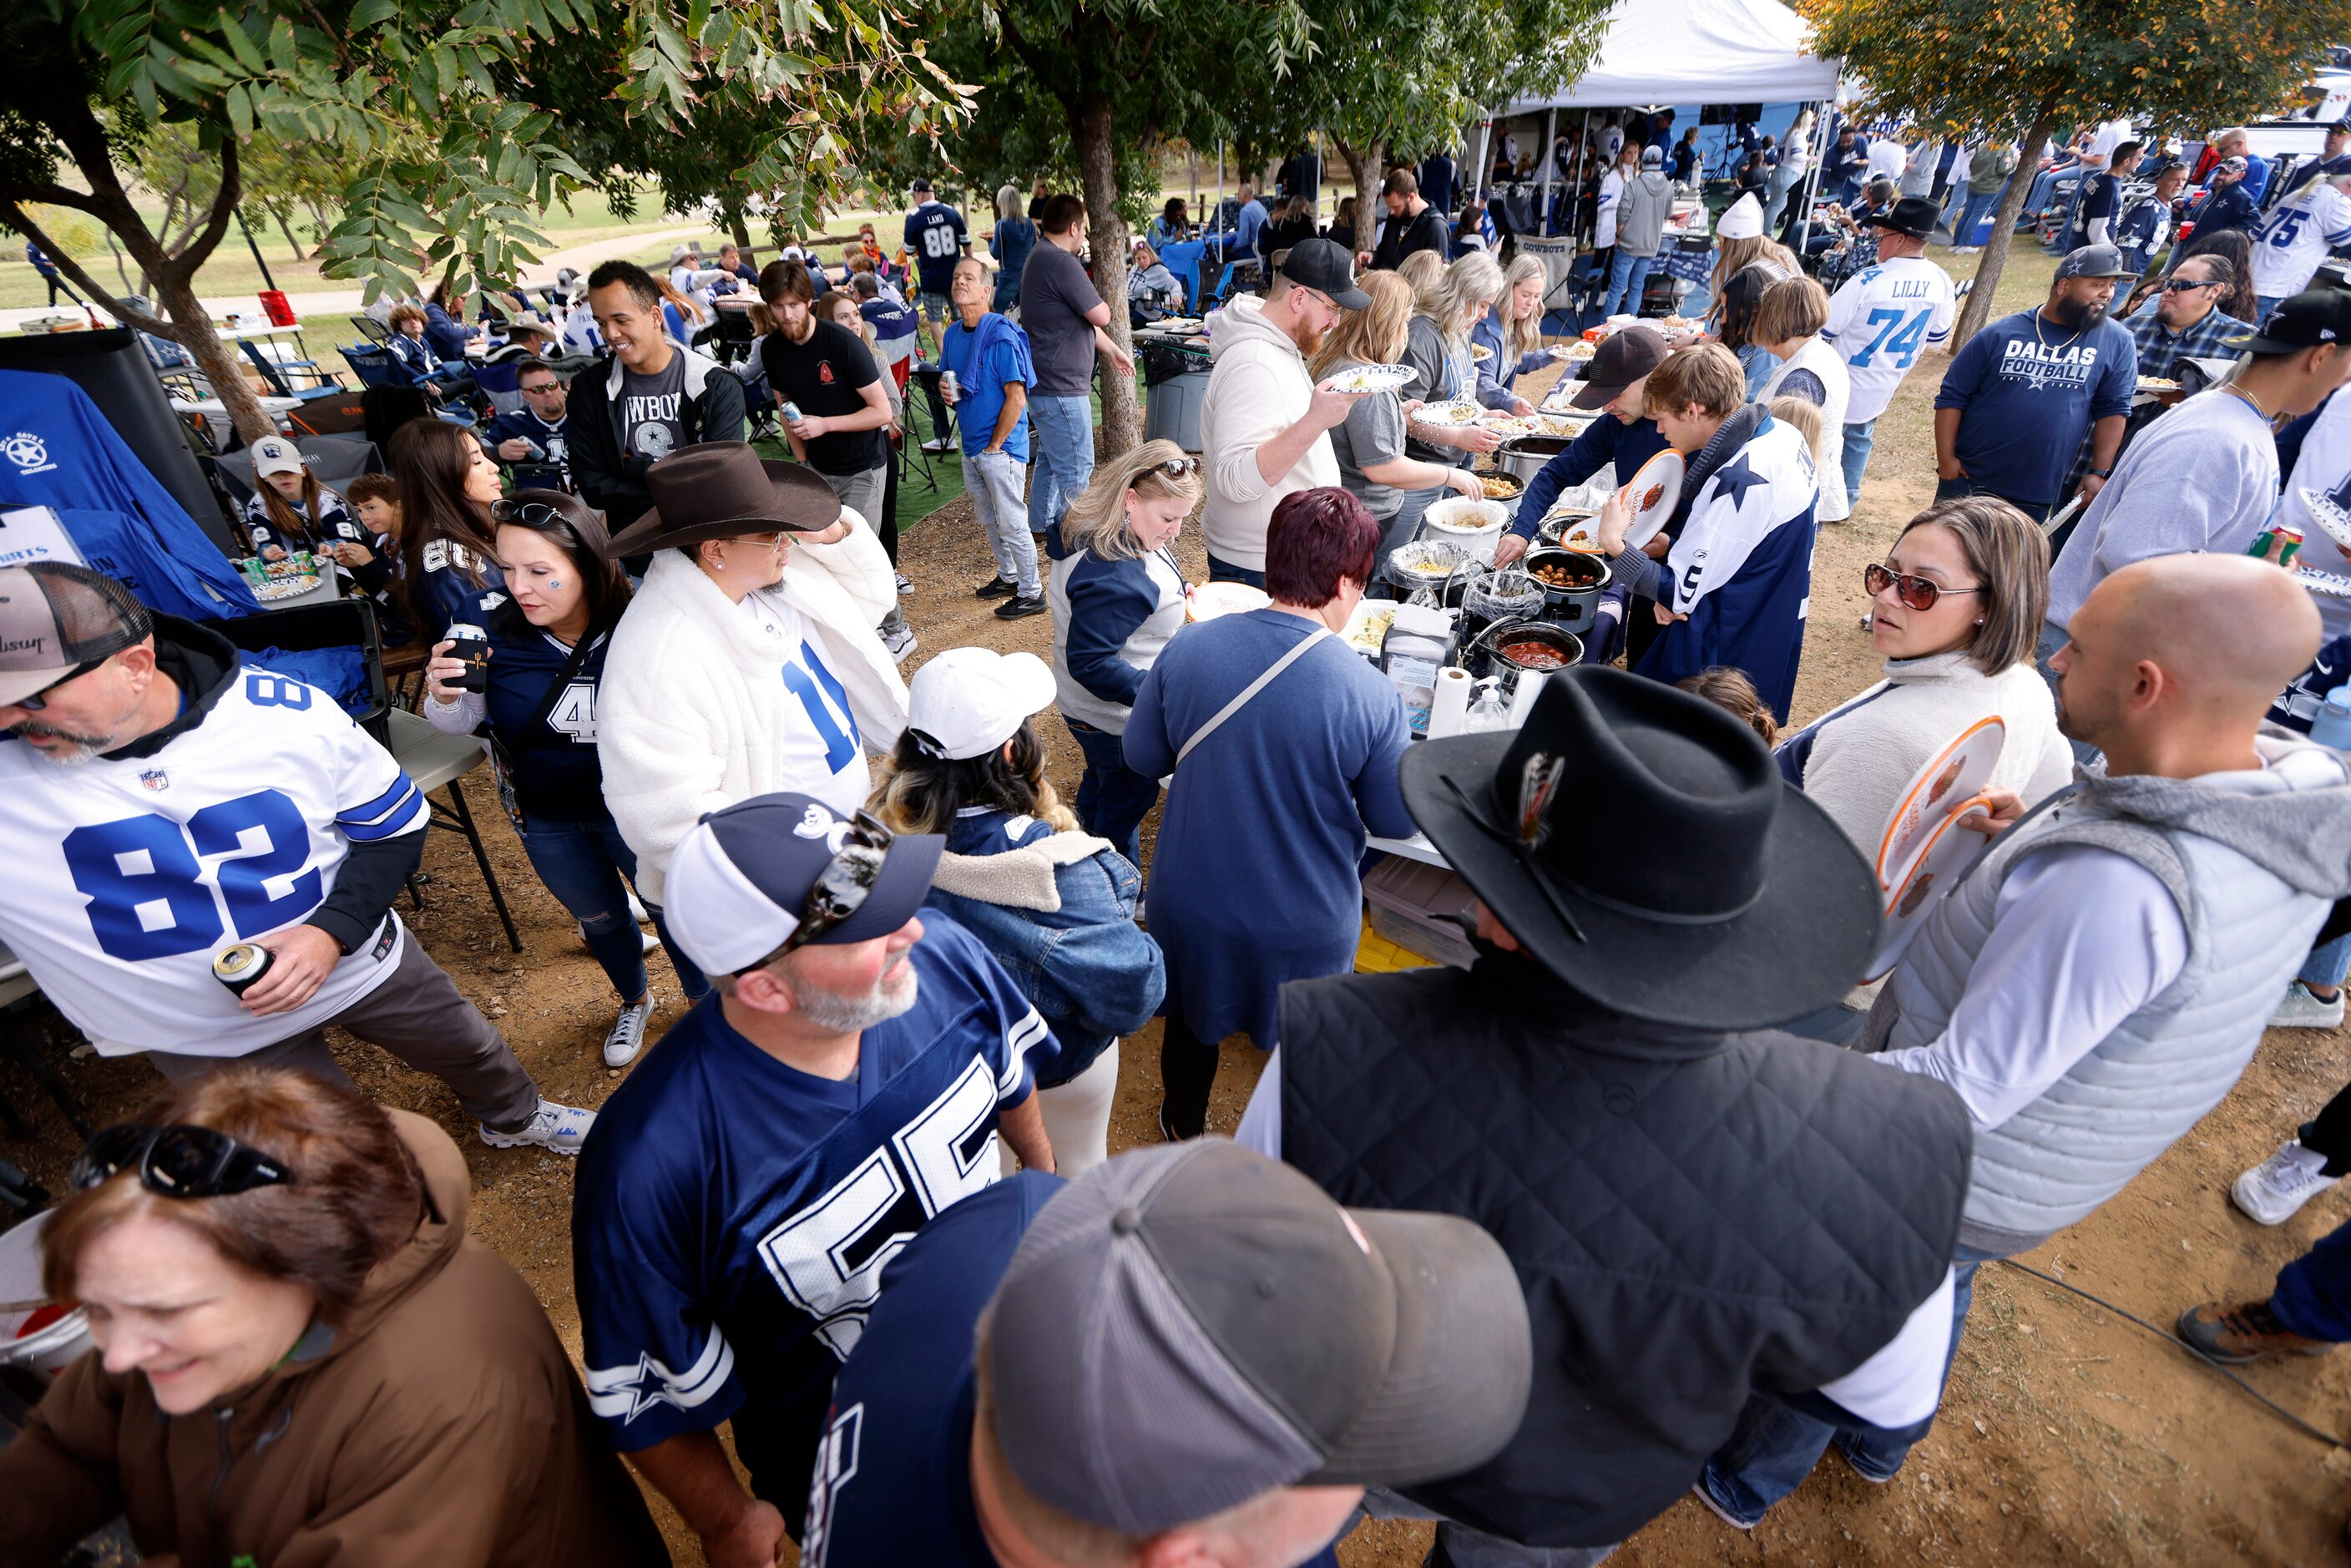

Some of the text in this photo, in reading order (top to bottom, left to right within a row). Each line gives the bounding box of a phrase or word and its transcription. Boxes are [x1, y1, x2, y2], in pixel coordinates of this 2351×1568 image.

[1610, 137, 1620, 154] 4
[927, 213, 945, 225] LAMB
[2256, 206, 2311, 248] 75
[923, 225, 957, 258] 88
[1523, 242, 1565, 253] COWBOYS
[1892, 281, 1930, 298] LILLY
[1848, 308, 1934, 368] 74
[2005, 339, 2097, 366] DALLAS
[2001, 358, 2086, 382] FOOTBALL
[626, 392, 681, 423] WBOY
[0, 545, 48, 563] IRTS
[479, 591, 508, 611] 4
[245, 674, 312, 711] 8
[546, 683, 598, 743] 4
[62, 788, 324, 962] 82
